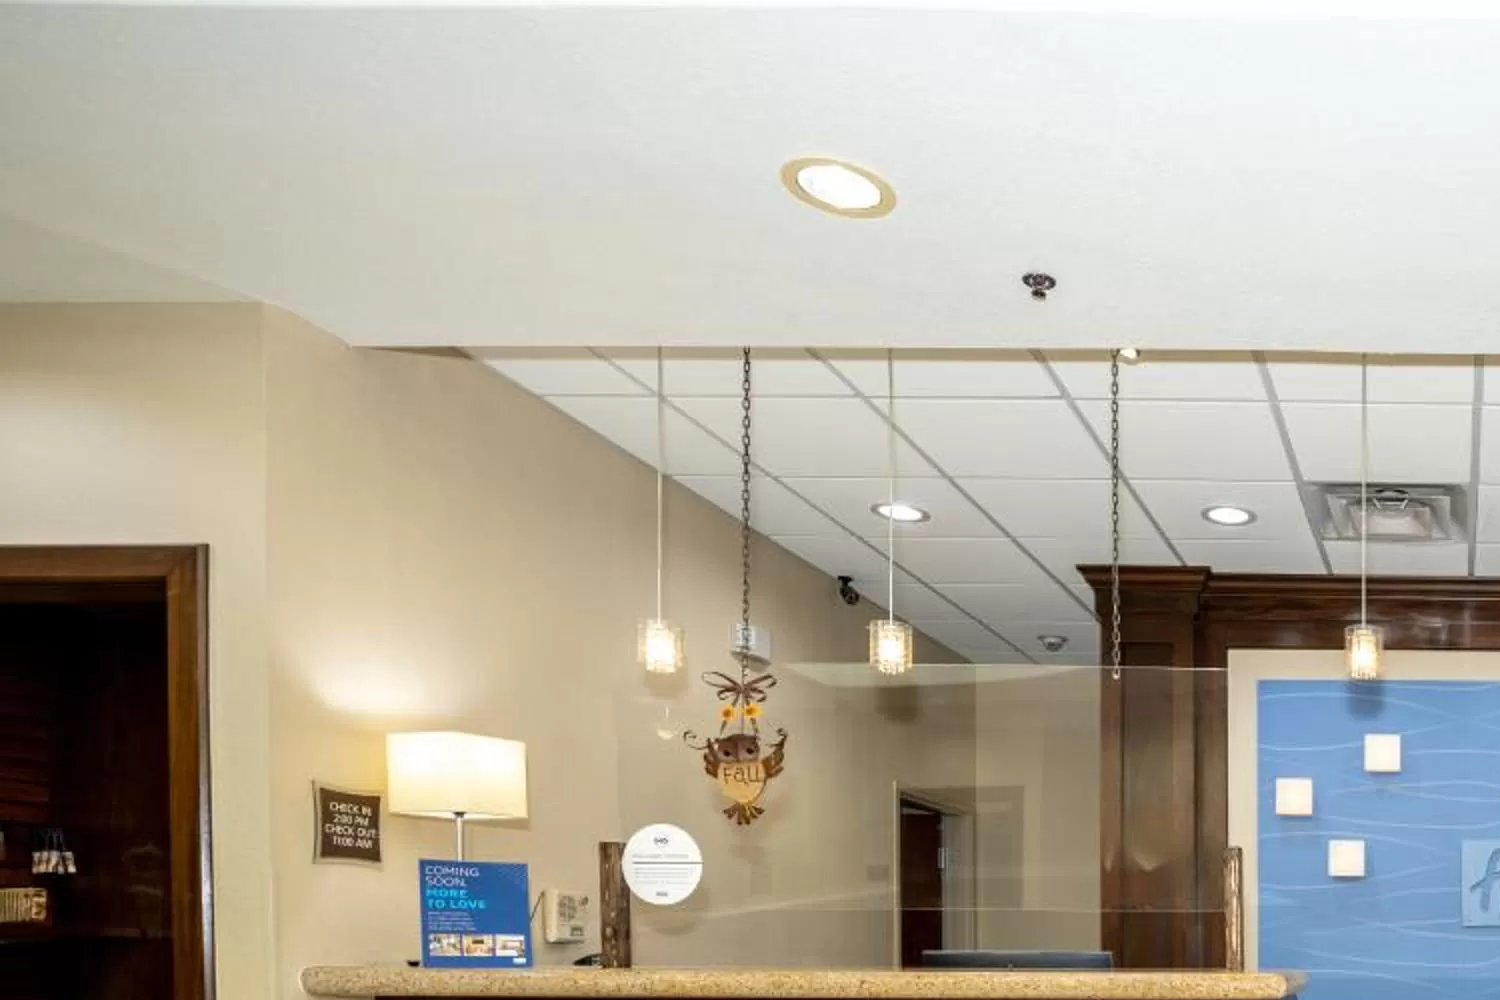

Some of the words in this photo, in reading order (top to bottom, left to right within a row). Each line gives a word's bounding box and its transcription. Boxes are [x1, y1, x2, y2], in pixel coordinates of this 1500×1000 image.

[329, 801, 360, 815] CHECK
[354, 815, 369, 827] PM
[323, 823, 355, 836] CHECK
[355, 838, 373, 849] AM
[425, 865, 480, 877] COMING
[426, 888, 469, 899] MORE
[427, 899, 446, 909] TO
[450, 899, 487, 910] LOVE
